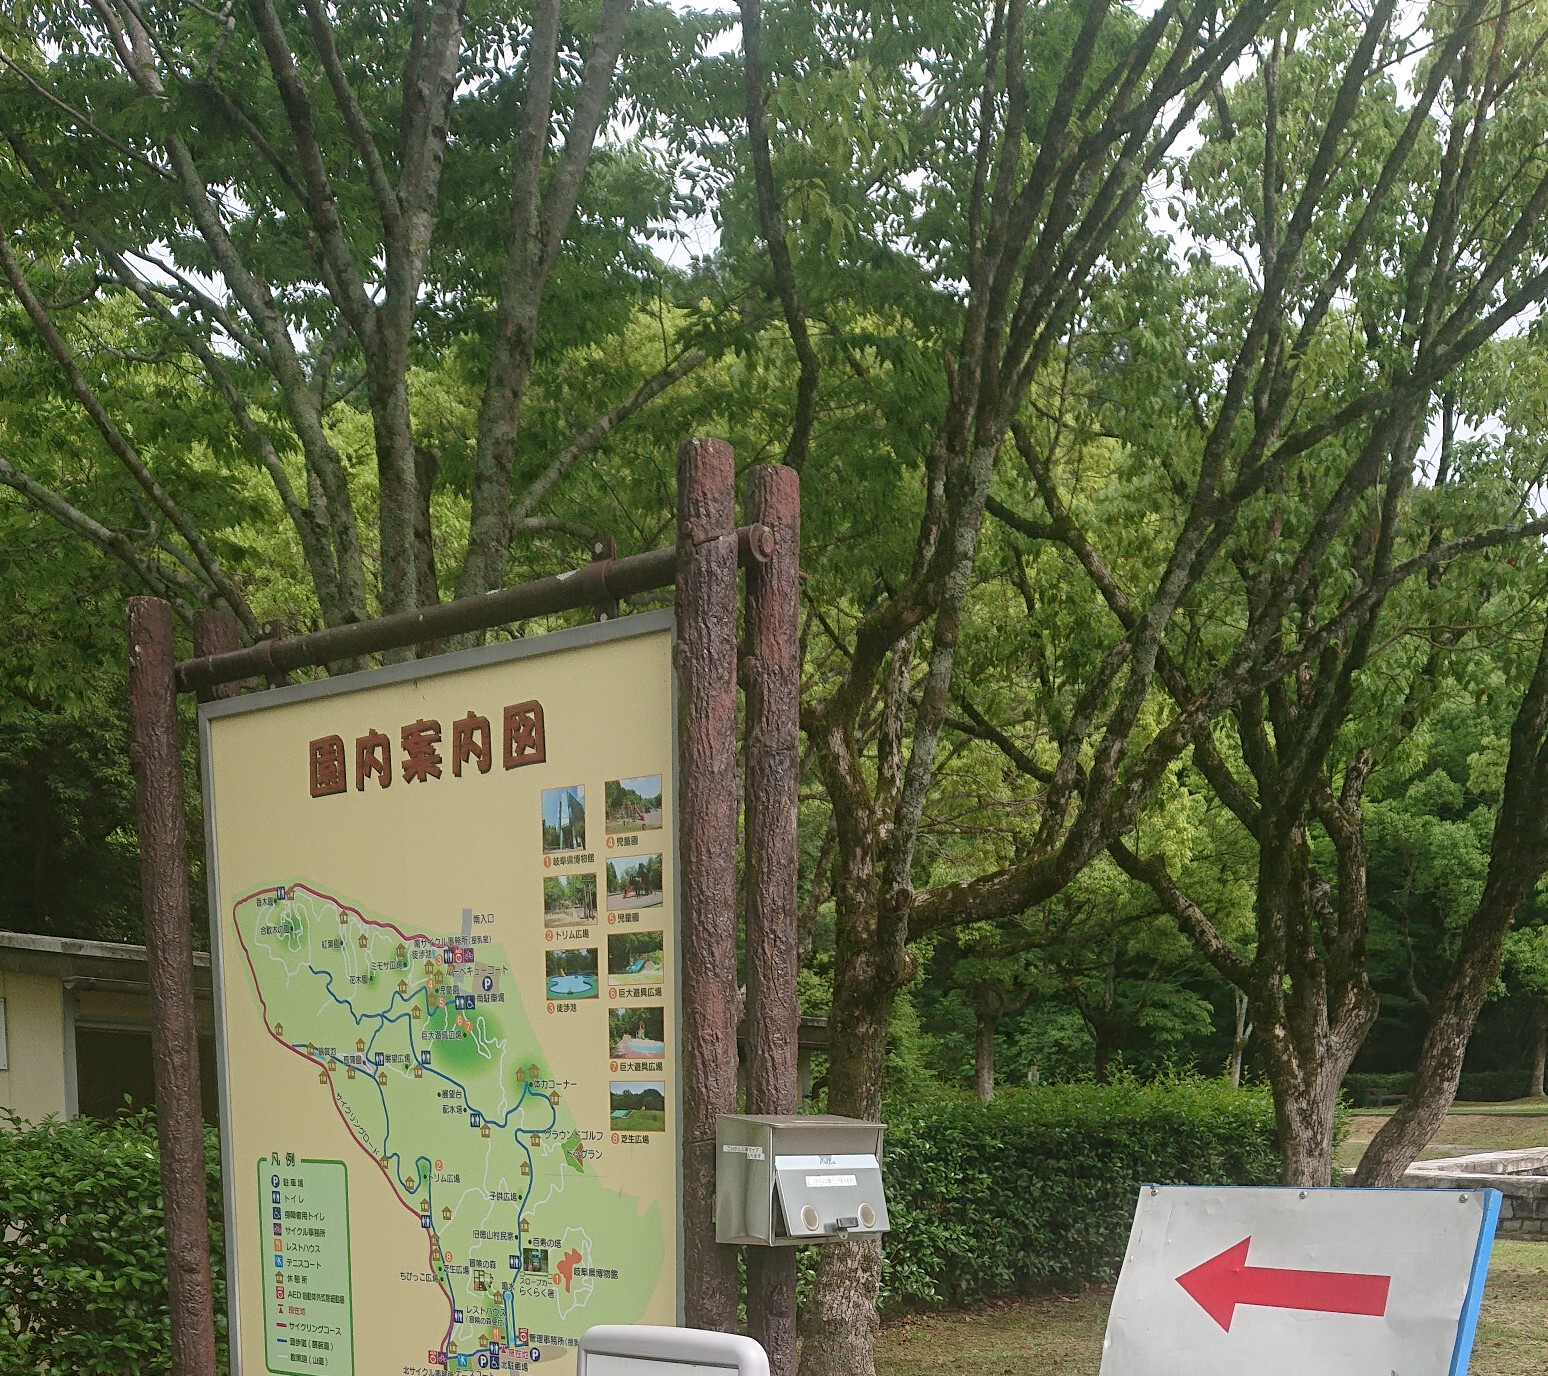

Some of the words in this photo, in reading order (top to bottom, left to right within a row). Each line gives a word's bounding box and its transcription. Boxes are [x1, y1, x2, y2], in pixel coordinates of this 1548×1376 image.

[309, 700, 546, 798] 園内案内図
[616, 836, 638, 847] 児童園
[553, 853, 594, 866] 岐阜県博物館
[474, 914, 494, 924] 南入口
[618, 912, 639, 923] 児童園
[556, 929, 589, 940] トリム広場
[618, 988, 662, 997] 巨大遊具広場
[620, 1062, 663, 1072] 巨大遊具広場
[336, 1093, 379, 1155] サイクリングロード
[621, 1135, 649, 1144] 芝生広場
[271, 1152, 295, 1167] 凡例
[283, 1179, 303, 1187] 駐車場
[285, 1195, 304, 1203] トイレ
[286, 1243, 320, 1253] レストハウス
[286, 1259, 321, 1269] テニスコート
[574, 1267, 618, 1279] 岐阜県博物館
[288, 1291, 301, 1299] AED
[467, 1305, 507, 1316] レストハウス
[289, 1322, 341, 1335] サイクリングコース
